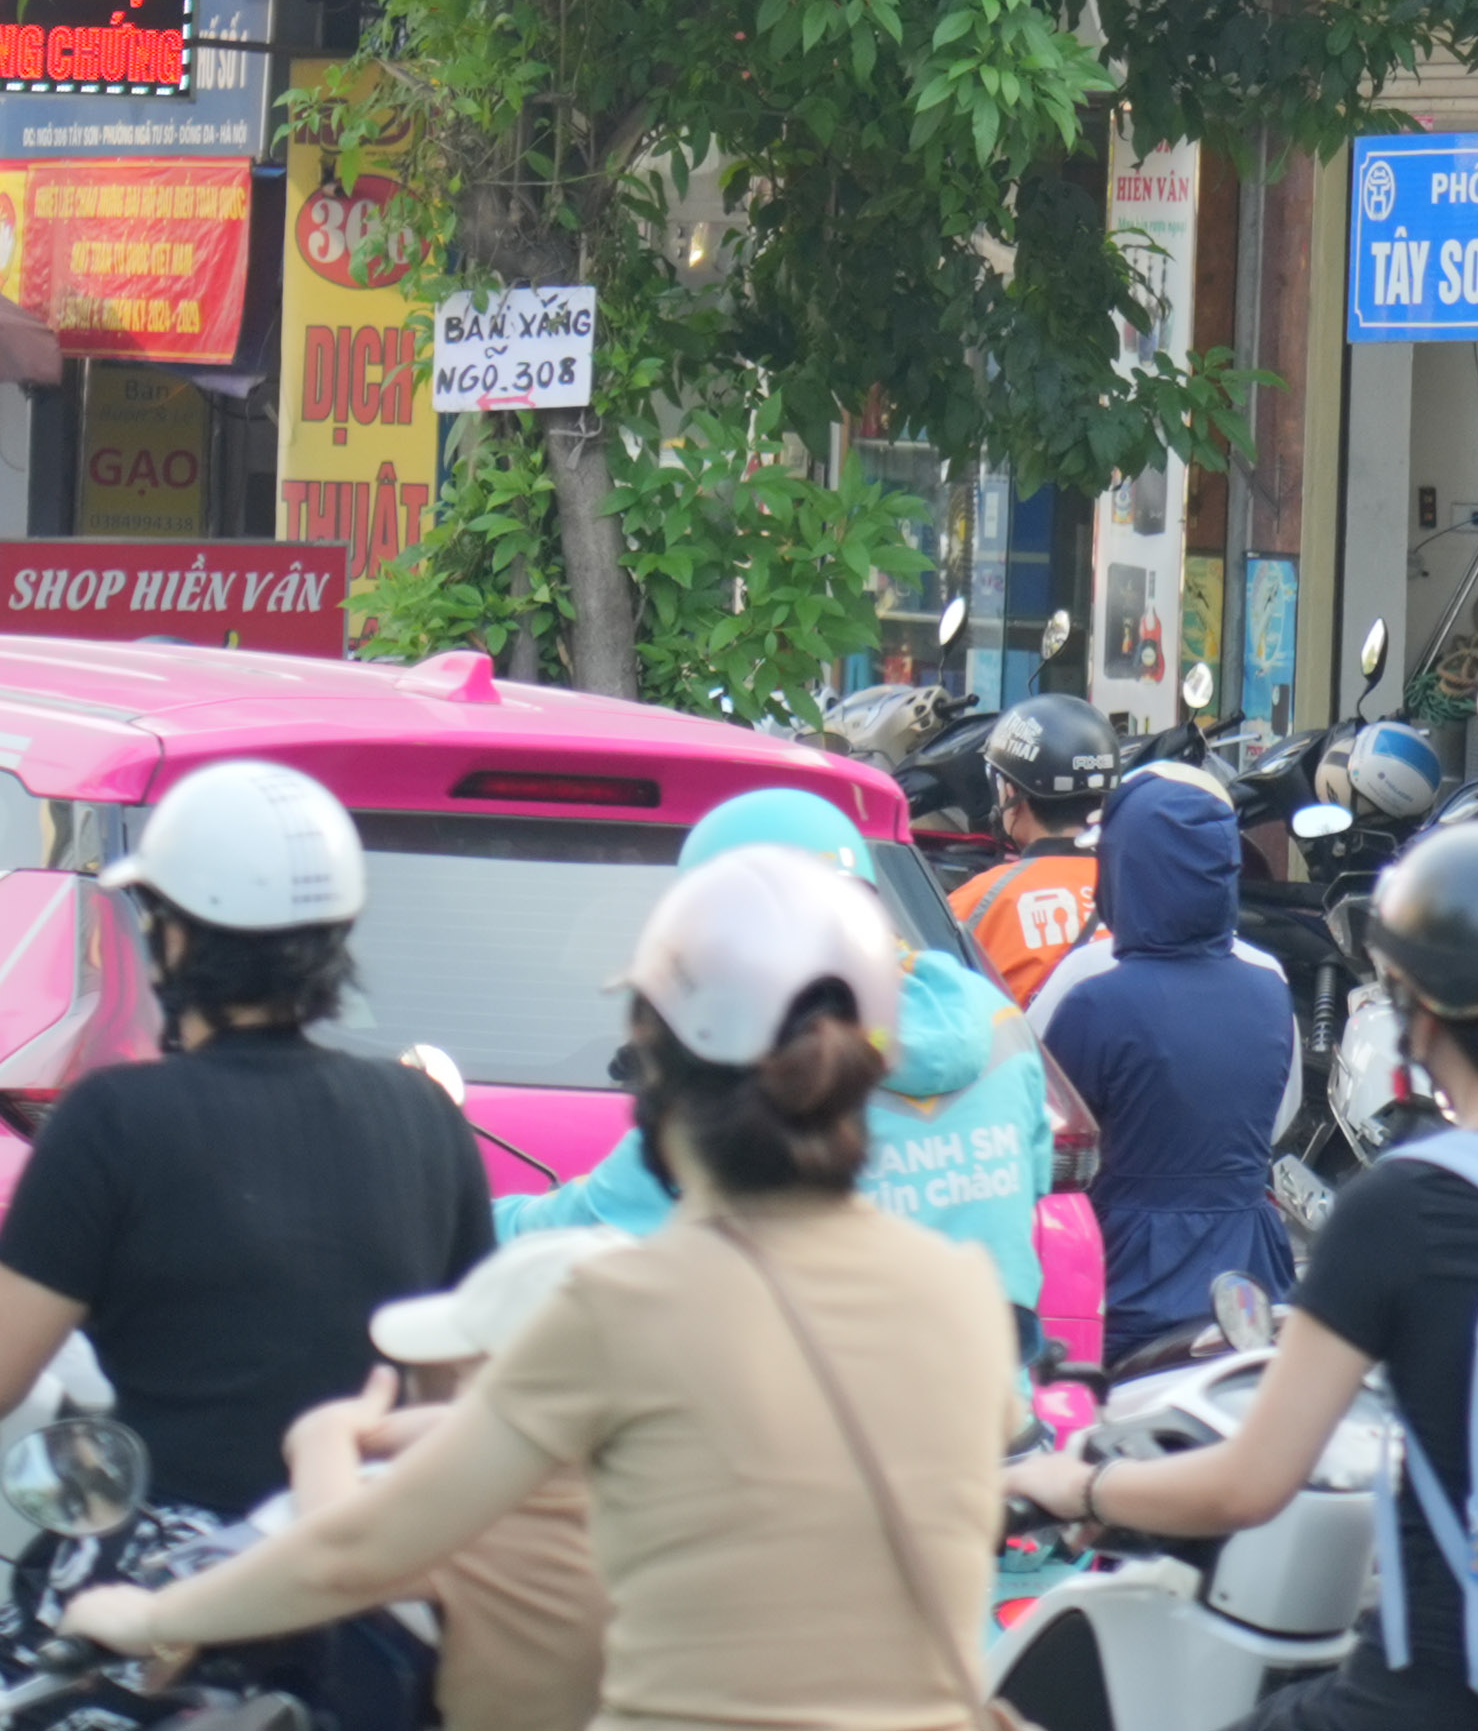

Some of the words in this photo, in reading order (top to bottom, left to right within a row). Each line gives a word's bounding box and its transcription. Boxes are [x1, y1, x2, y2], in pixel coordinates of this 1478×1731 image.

[1372, 227, 1430, 305] TÂY
[301, 324, 414, 445] DỊCH
[88, 447, 198, 497] GẠO
[8, 568, 126, 610] SHOP
[130, 553, 236, 612] HIỀN
[242, 561, 330, 613] VÂN
[970, 1123, 1020, 1160] SM
[925, 1162, 1021, 1207] chào!
